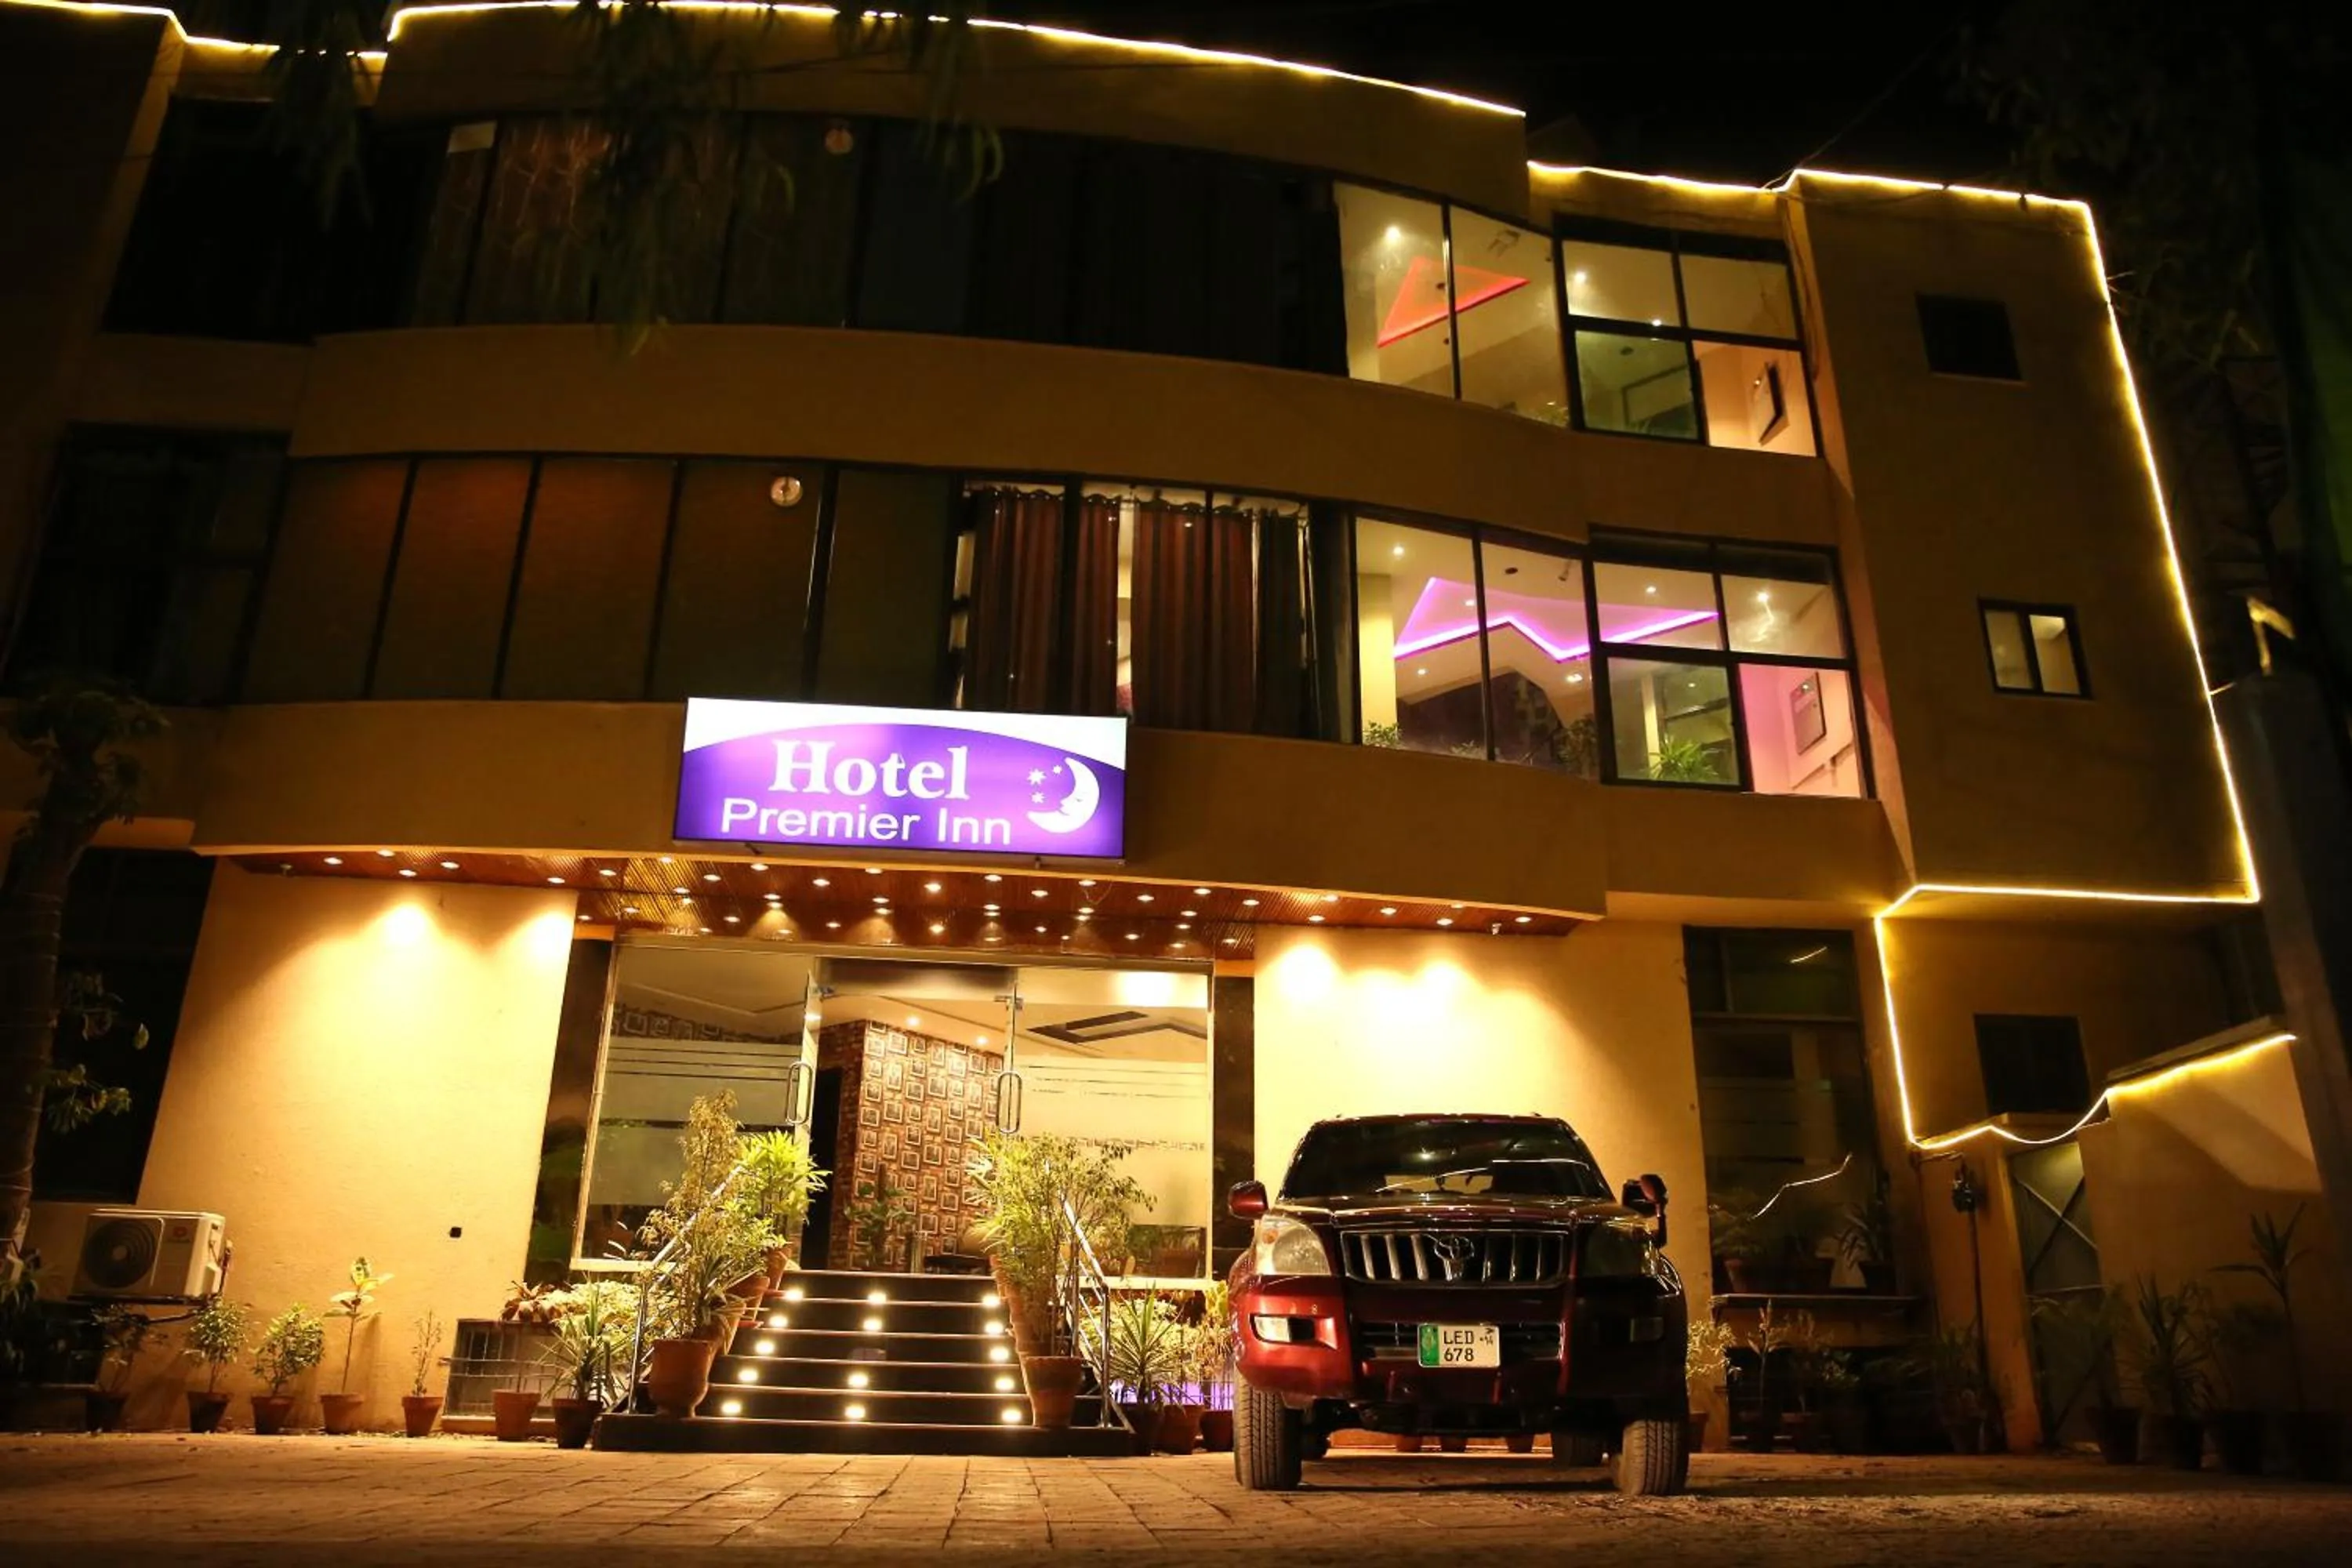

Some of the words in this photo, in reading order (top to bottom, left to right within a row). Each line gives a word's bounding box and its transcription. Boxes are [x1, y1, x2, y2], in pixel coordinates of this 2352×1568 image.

[768, 738, 969, 800] Hotel
[721, 797, 920, 840] Premier
[938, 808, 1011, 844] Inn
[1443, 1330, 1474, 1345] LED
[1443, 1348, 1474, 1361] 678
